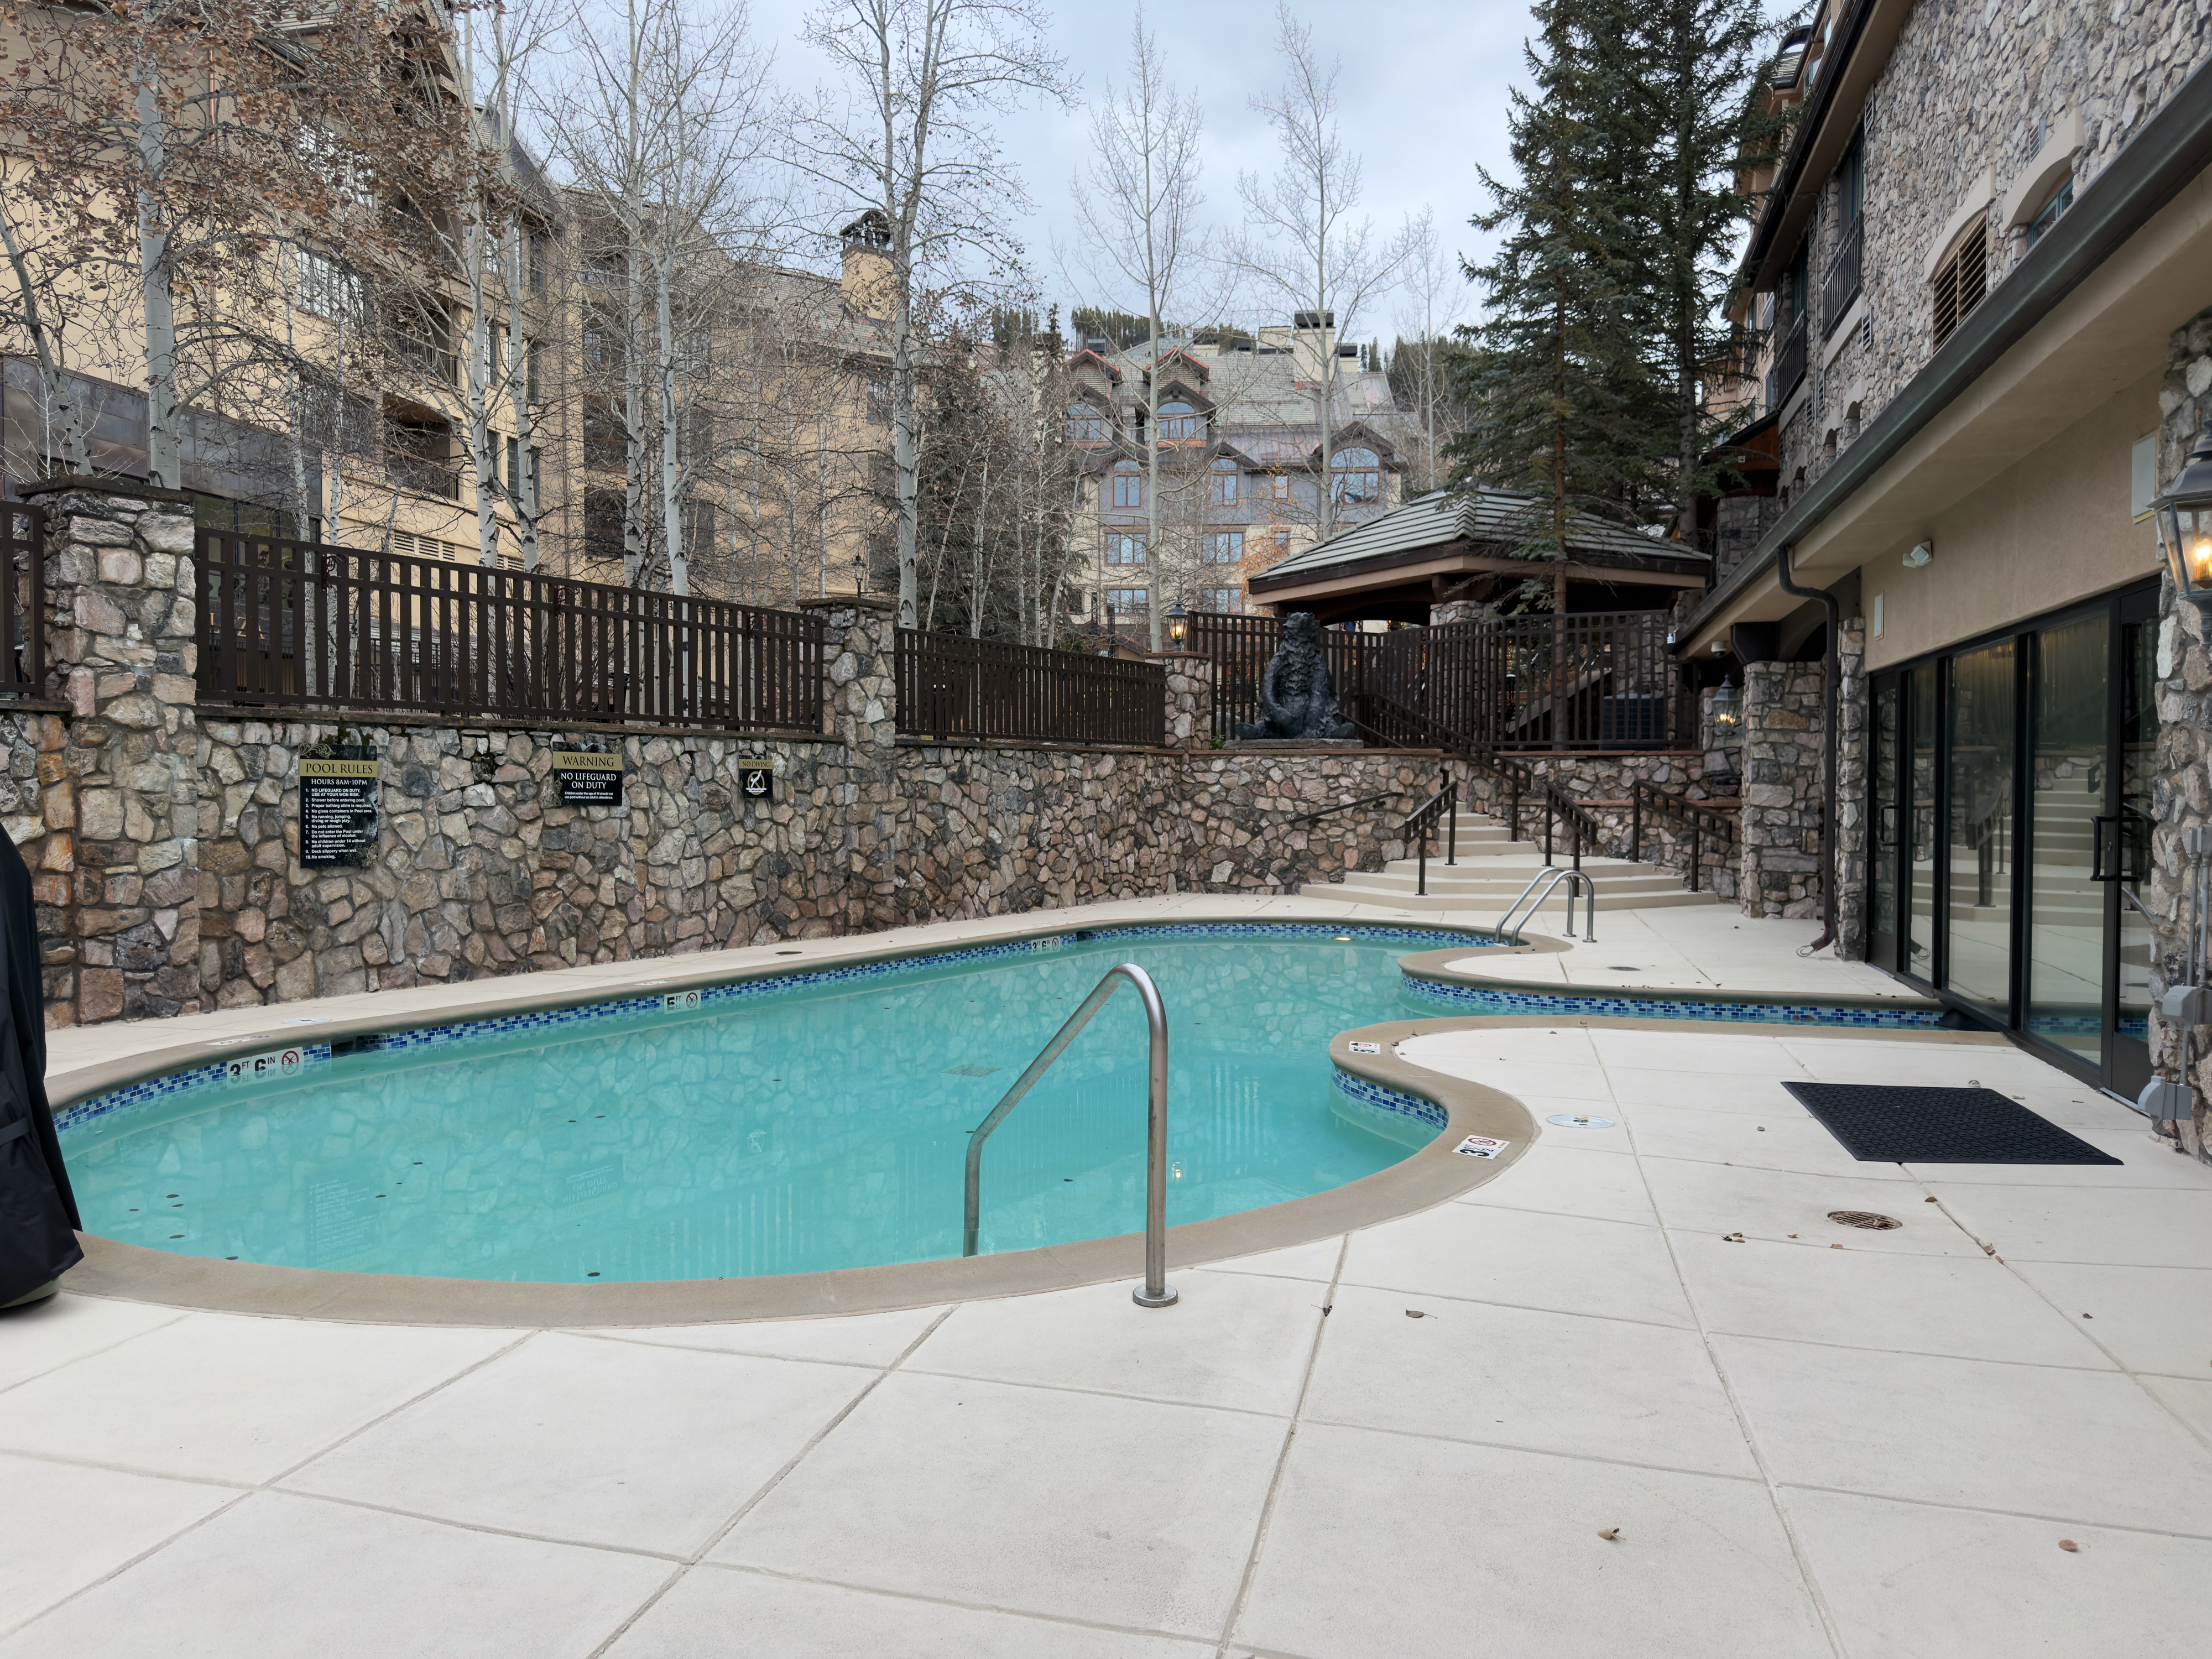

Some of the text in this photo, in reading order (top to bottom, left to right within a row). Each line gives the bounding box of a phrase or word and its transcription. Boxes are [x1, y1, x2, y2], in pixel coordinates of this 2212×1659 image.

[563, 756, 614, 766] WARNING
[306, 763, 373, 774] POOL RULES
[667, 997, 675, 1005] 5
[230, 1063, 241, 1076] 3
[242, 1061, 249, 1069] FT
